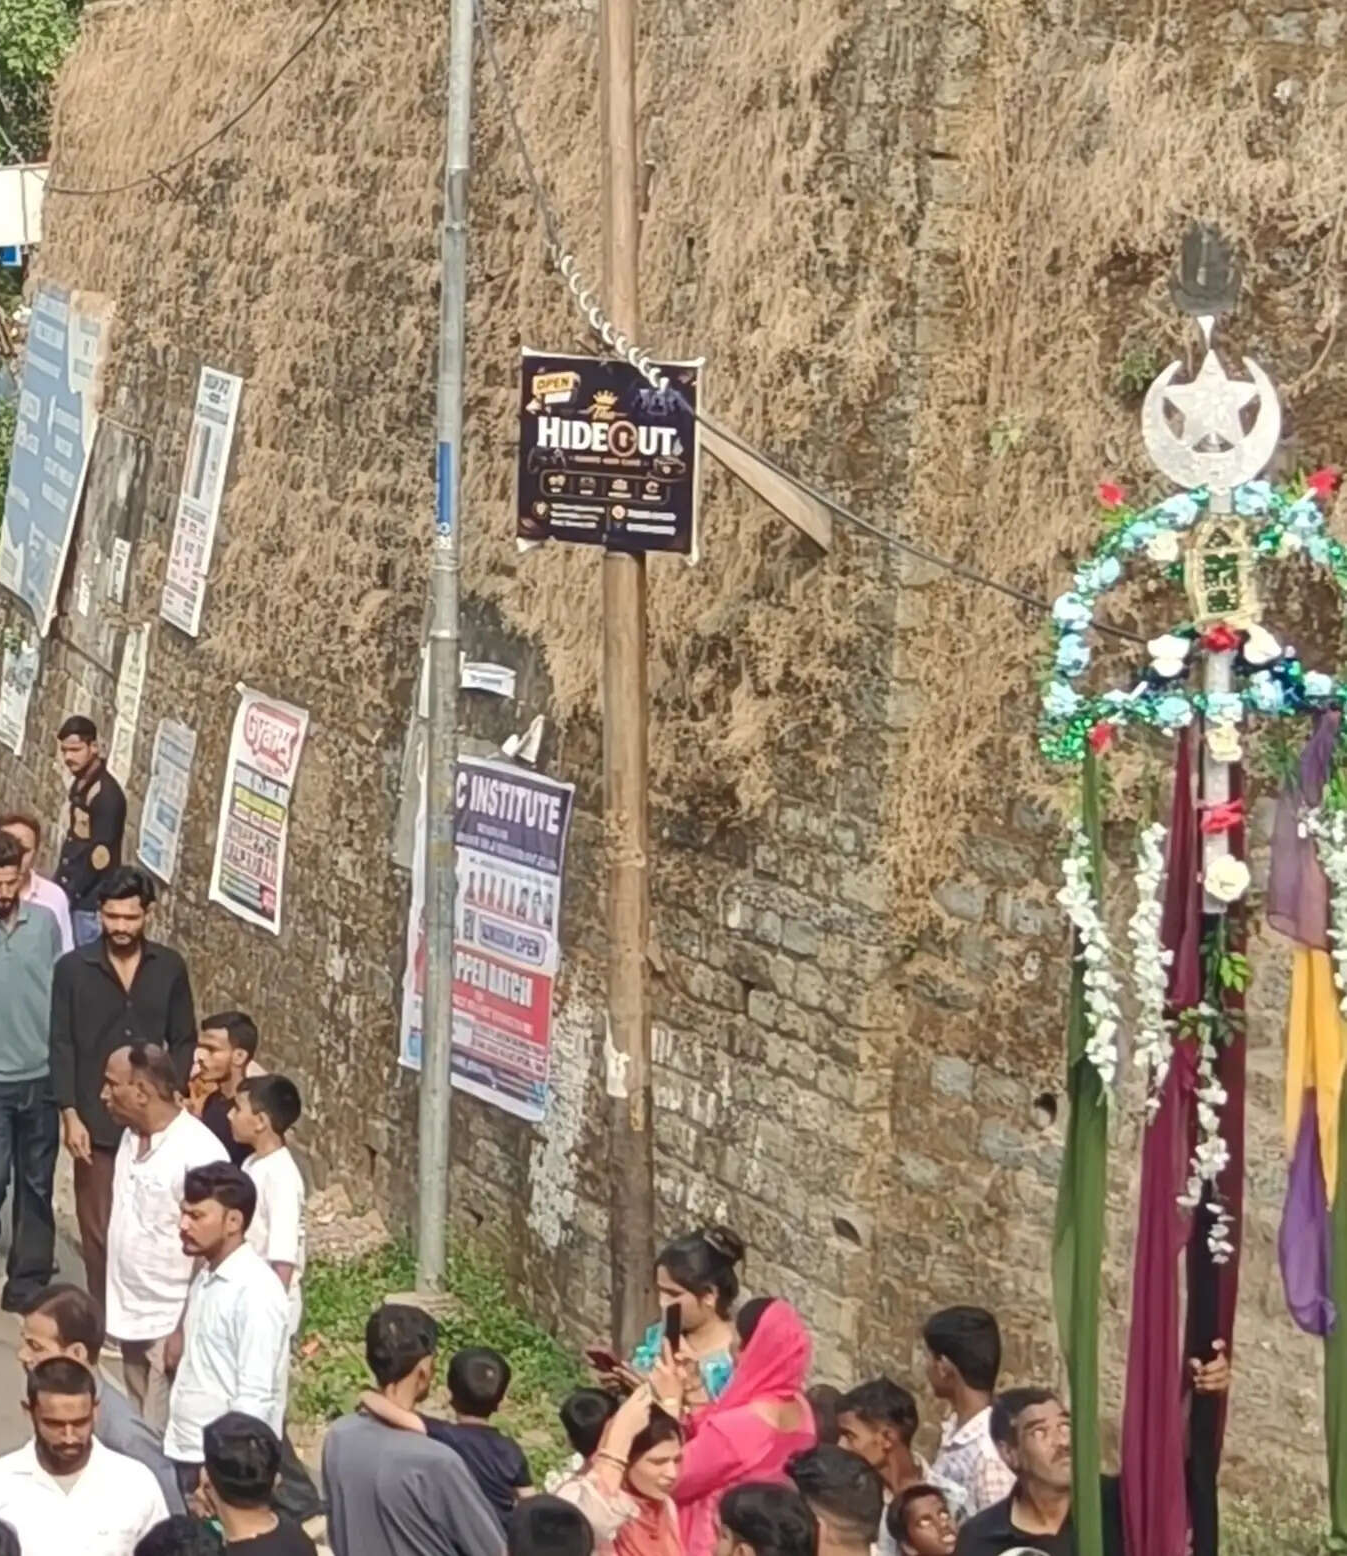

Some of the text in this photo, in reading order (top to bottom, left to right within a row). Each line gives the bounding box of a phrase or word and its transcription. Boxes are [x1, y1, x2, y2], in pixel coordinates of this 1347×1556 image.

[536, 376, 571, 390] OPEN
[537, 416, 678, 457] HIDEOUT
[469, 774, 562, 835] INSTITUTE
